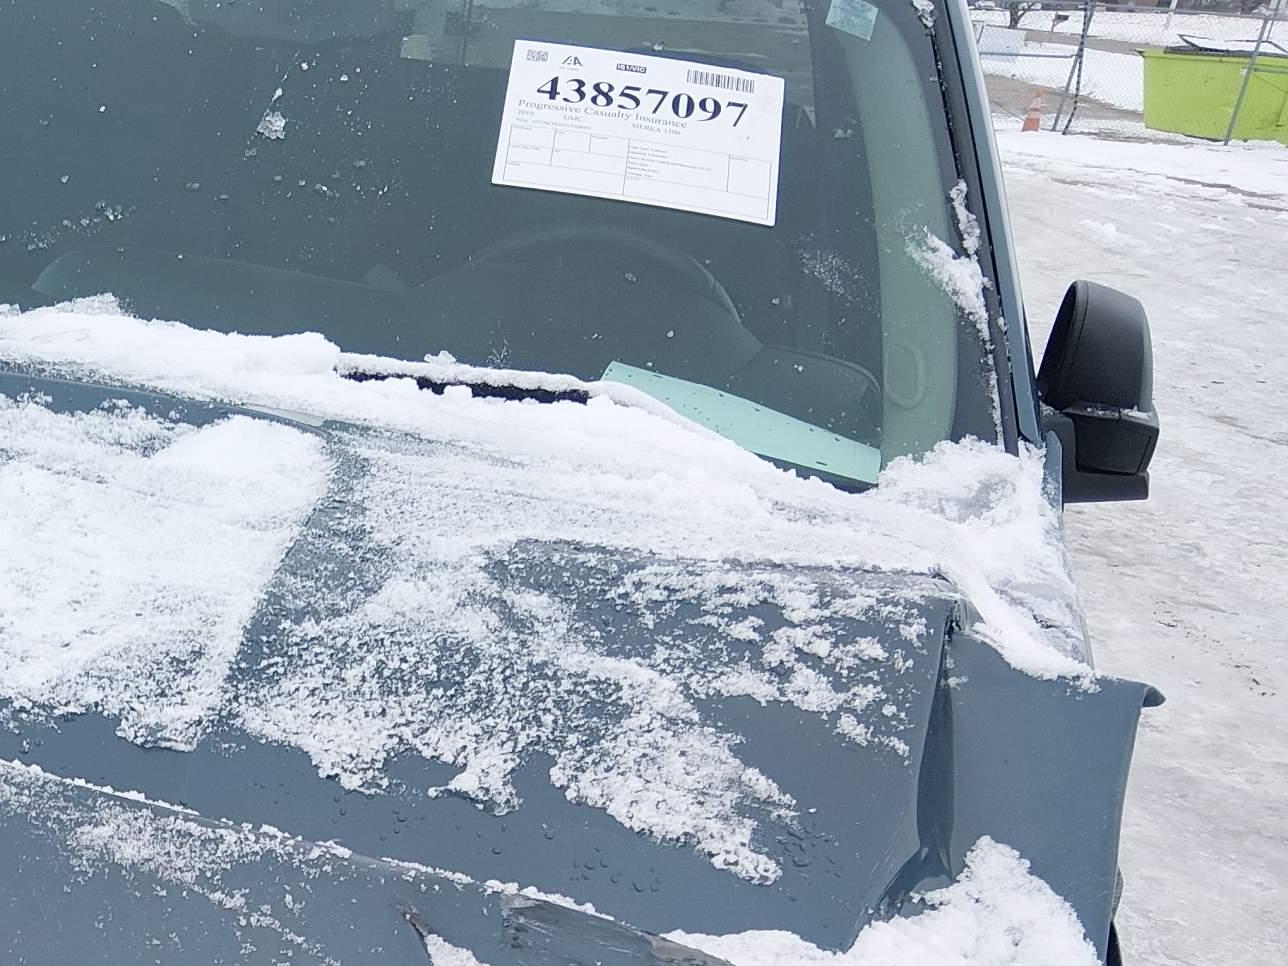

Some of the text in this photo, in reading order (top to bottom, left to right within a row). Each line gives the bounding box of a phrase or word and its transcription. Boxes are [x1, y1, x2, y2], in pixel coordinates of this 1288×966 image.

[518, 99, 688, 128] Progressive Casualty Insurance
[537, 76, 749, 128] 43857097
